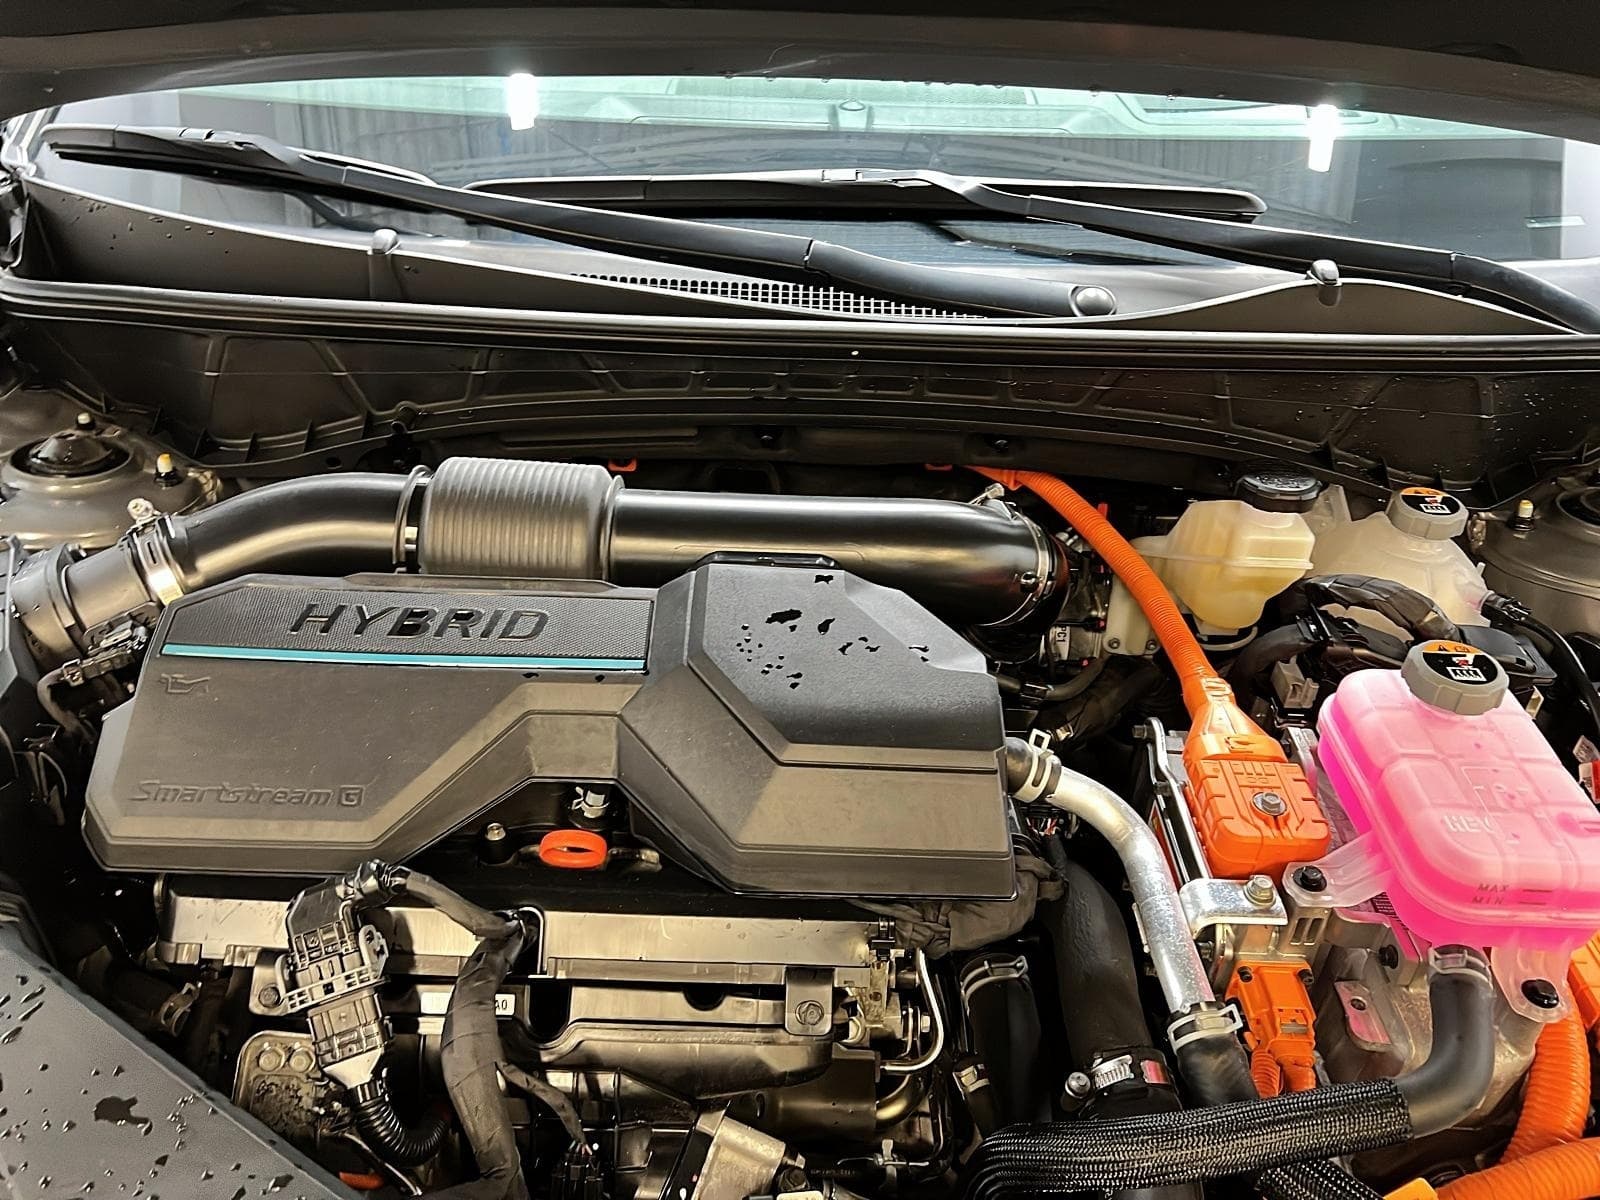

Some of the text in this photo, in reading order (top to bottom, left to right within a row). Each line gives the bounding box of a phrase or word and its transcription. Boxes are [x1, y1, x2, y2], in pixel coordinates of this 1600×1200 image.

[289, 603, 549, 642] HYBRID
[130, 779, 365, 807] Smartstream G
[1477, 883, 1510, 893] MAX
[1471, 896, 1505, 905] MIN
